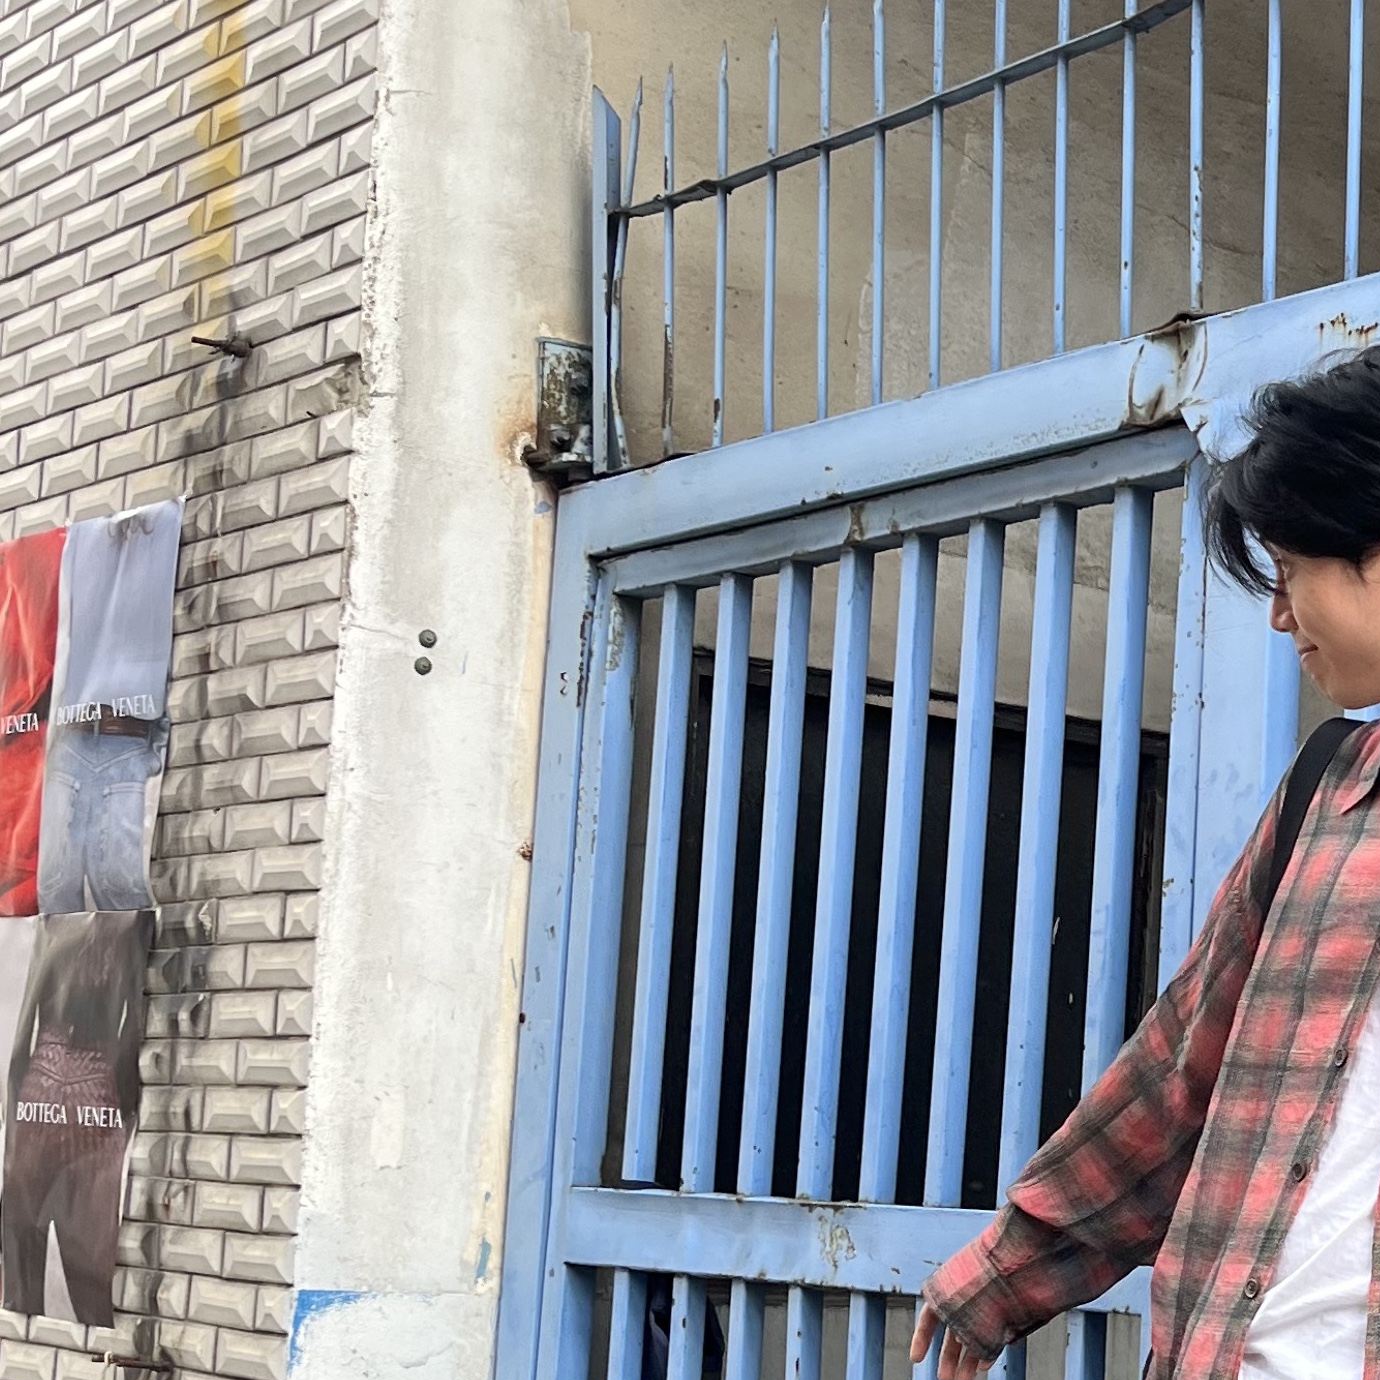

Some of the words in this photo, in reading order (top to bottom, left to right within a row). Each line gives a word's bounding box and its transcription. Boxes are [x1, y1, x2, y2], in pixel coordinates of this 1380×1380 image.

[57, 701, 102, 725] BOTTEGA
[112, 694, 156, 717] VENETA
[0, 713, 39, 735] VENETA
[16, 1102, 68, 1124] BOTTEGA
[76, 1105, 123, 1128] VENETA
